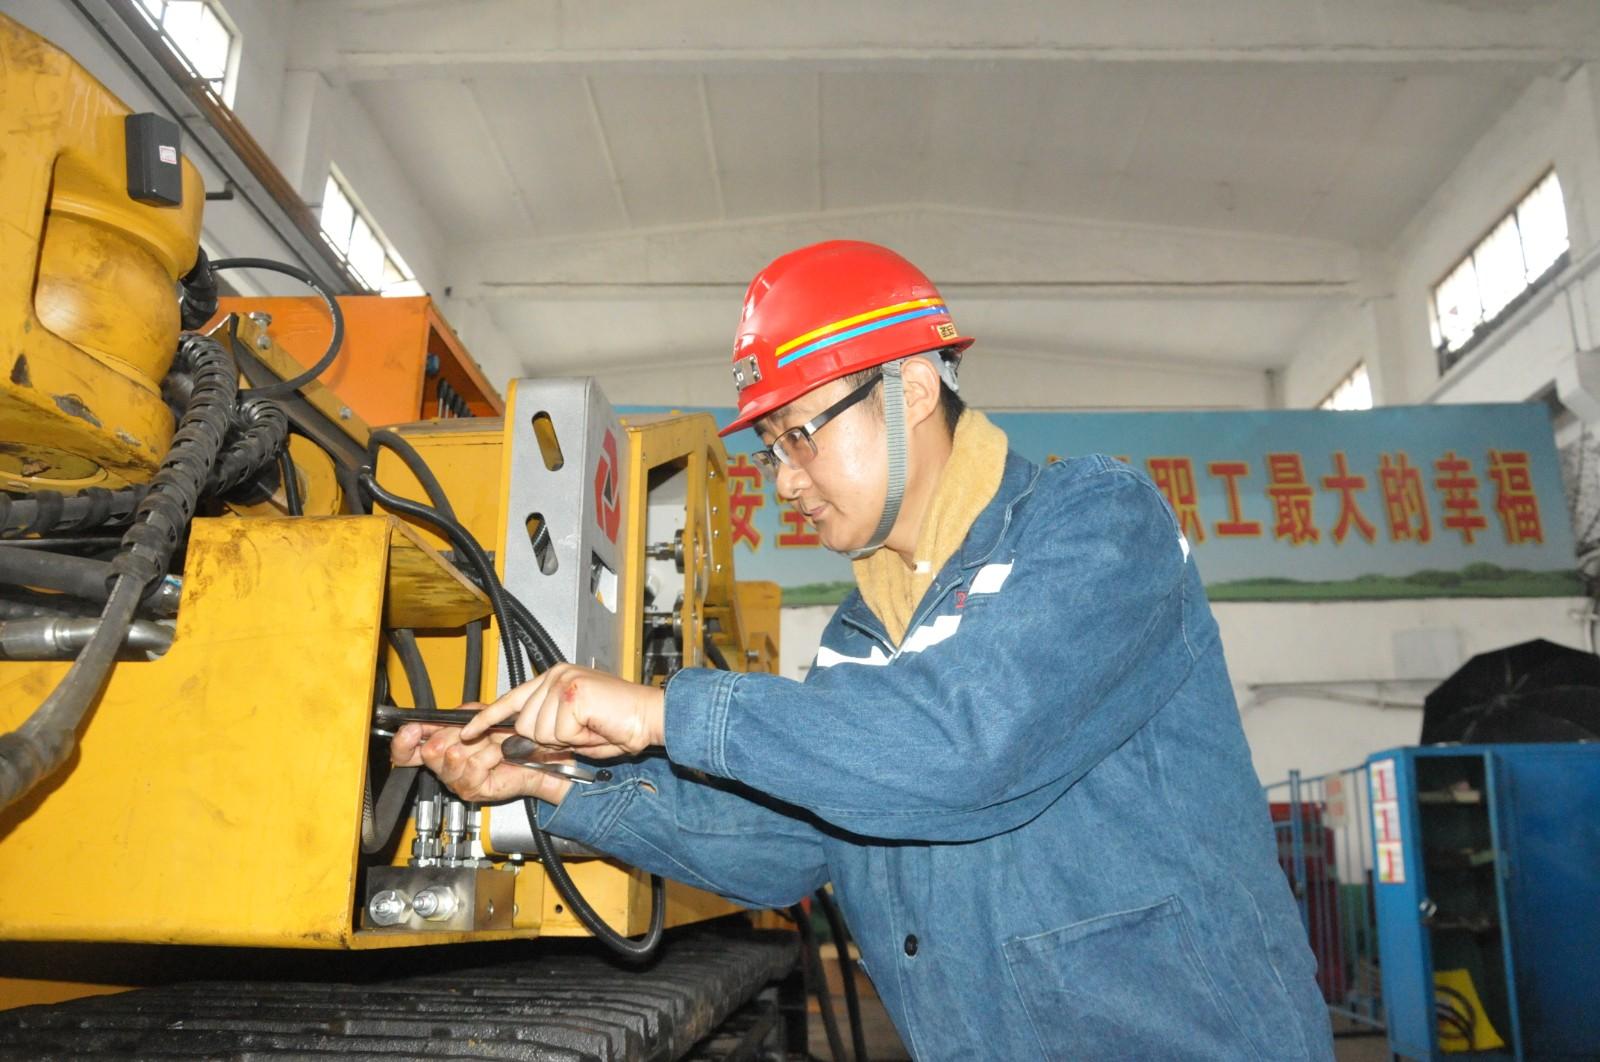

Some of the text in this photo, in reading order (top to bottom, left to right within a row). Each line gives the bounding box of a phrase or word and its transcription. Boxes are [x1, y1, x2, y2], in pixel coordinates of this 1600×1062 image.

[1146, 449, 1545, 545] 职工最大的幸福
